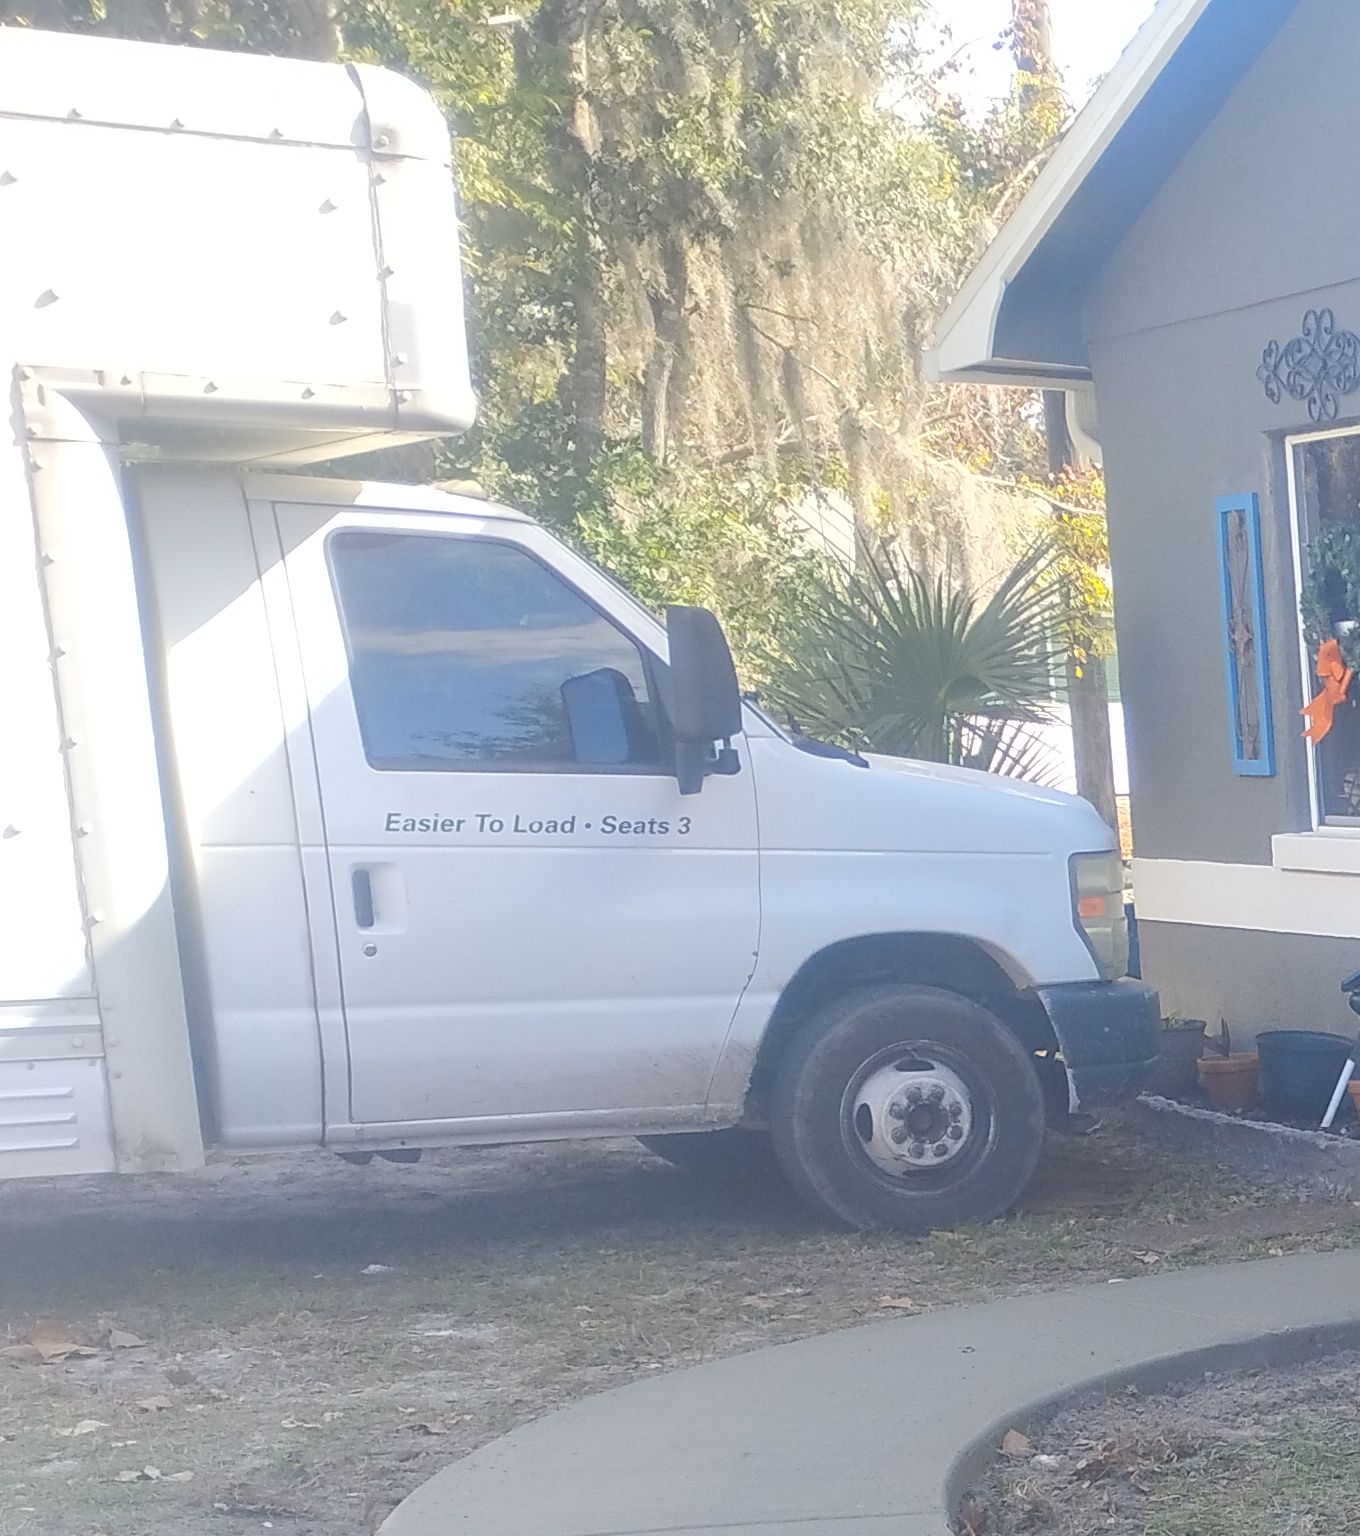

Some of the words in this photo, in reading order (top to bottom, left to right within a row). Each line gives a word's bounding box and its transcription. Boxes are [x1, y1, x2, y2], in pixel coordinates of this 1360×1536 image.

[384, 812, 466, 833] Easier
[475, 813, 504, 833] To
[513, 814, 576, 834] Load
[600, 815, 670, 835] Seats
[677, 816, 692, 835] 3
